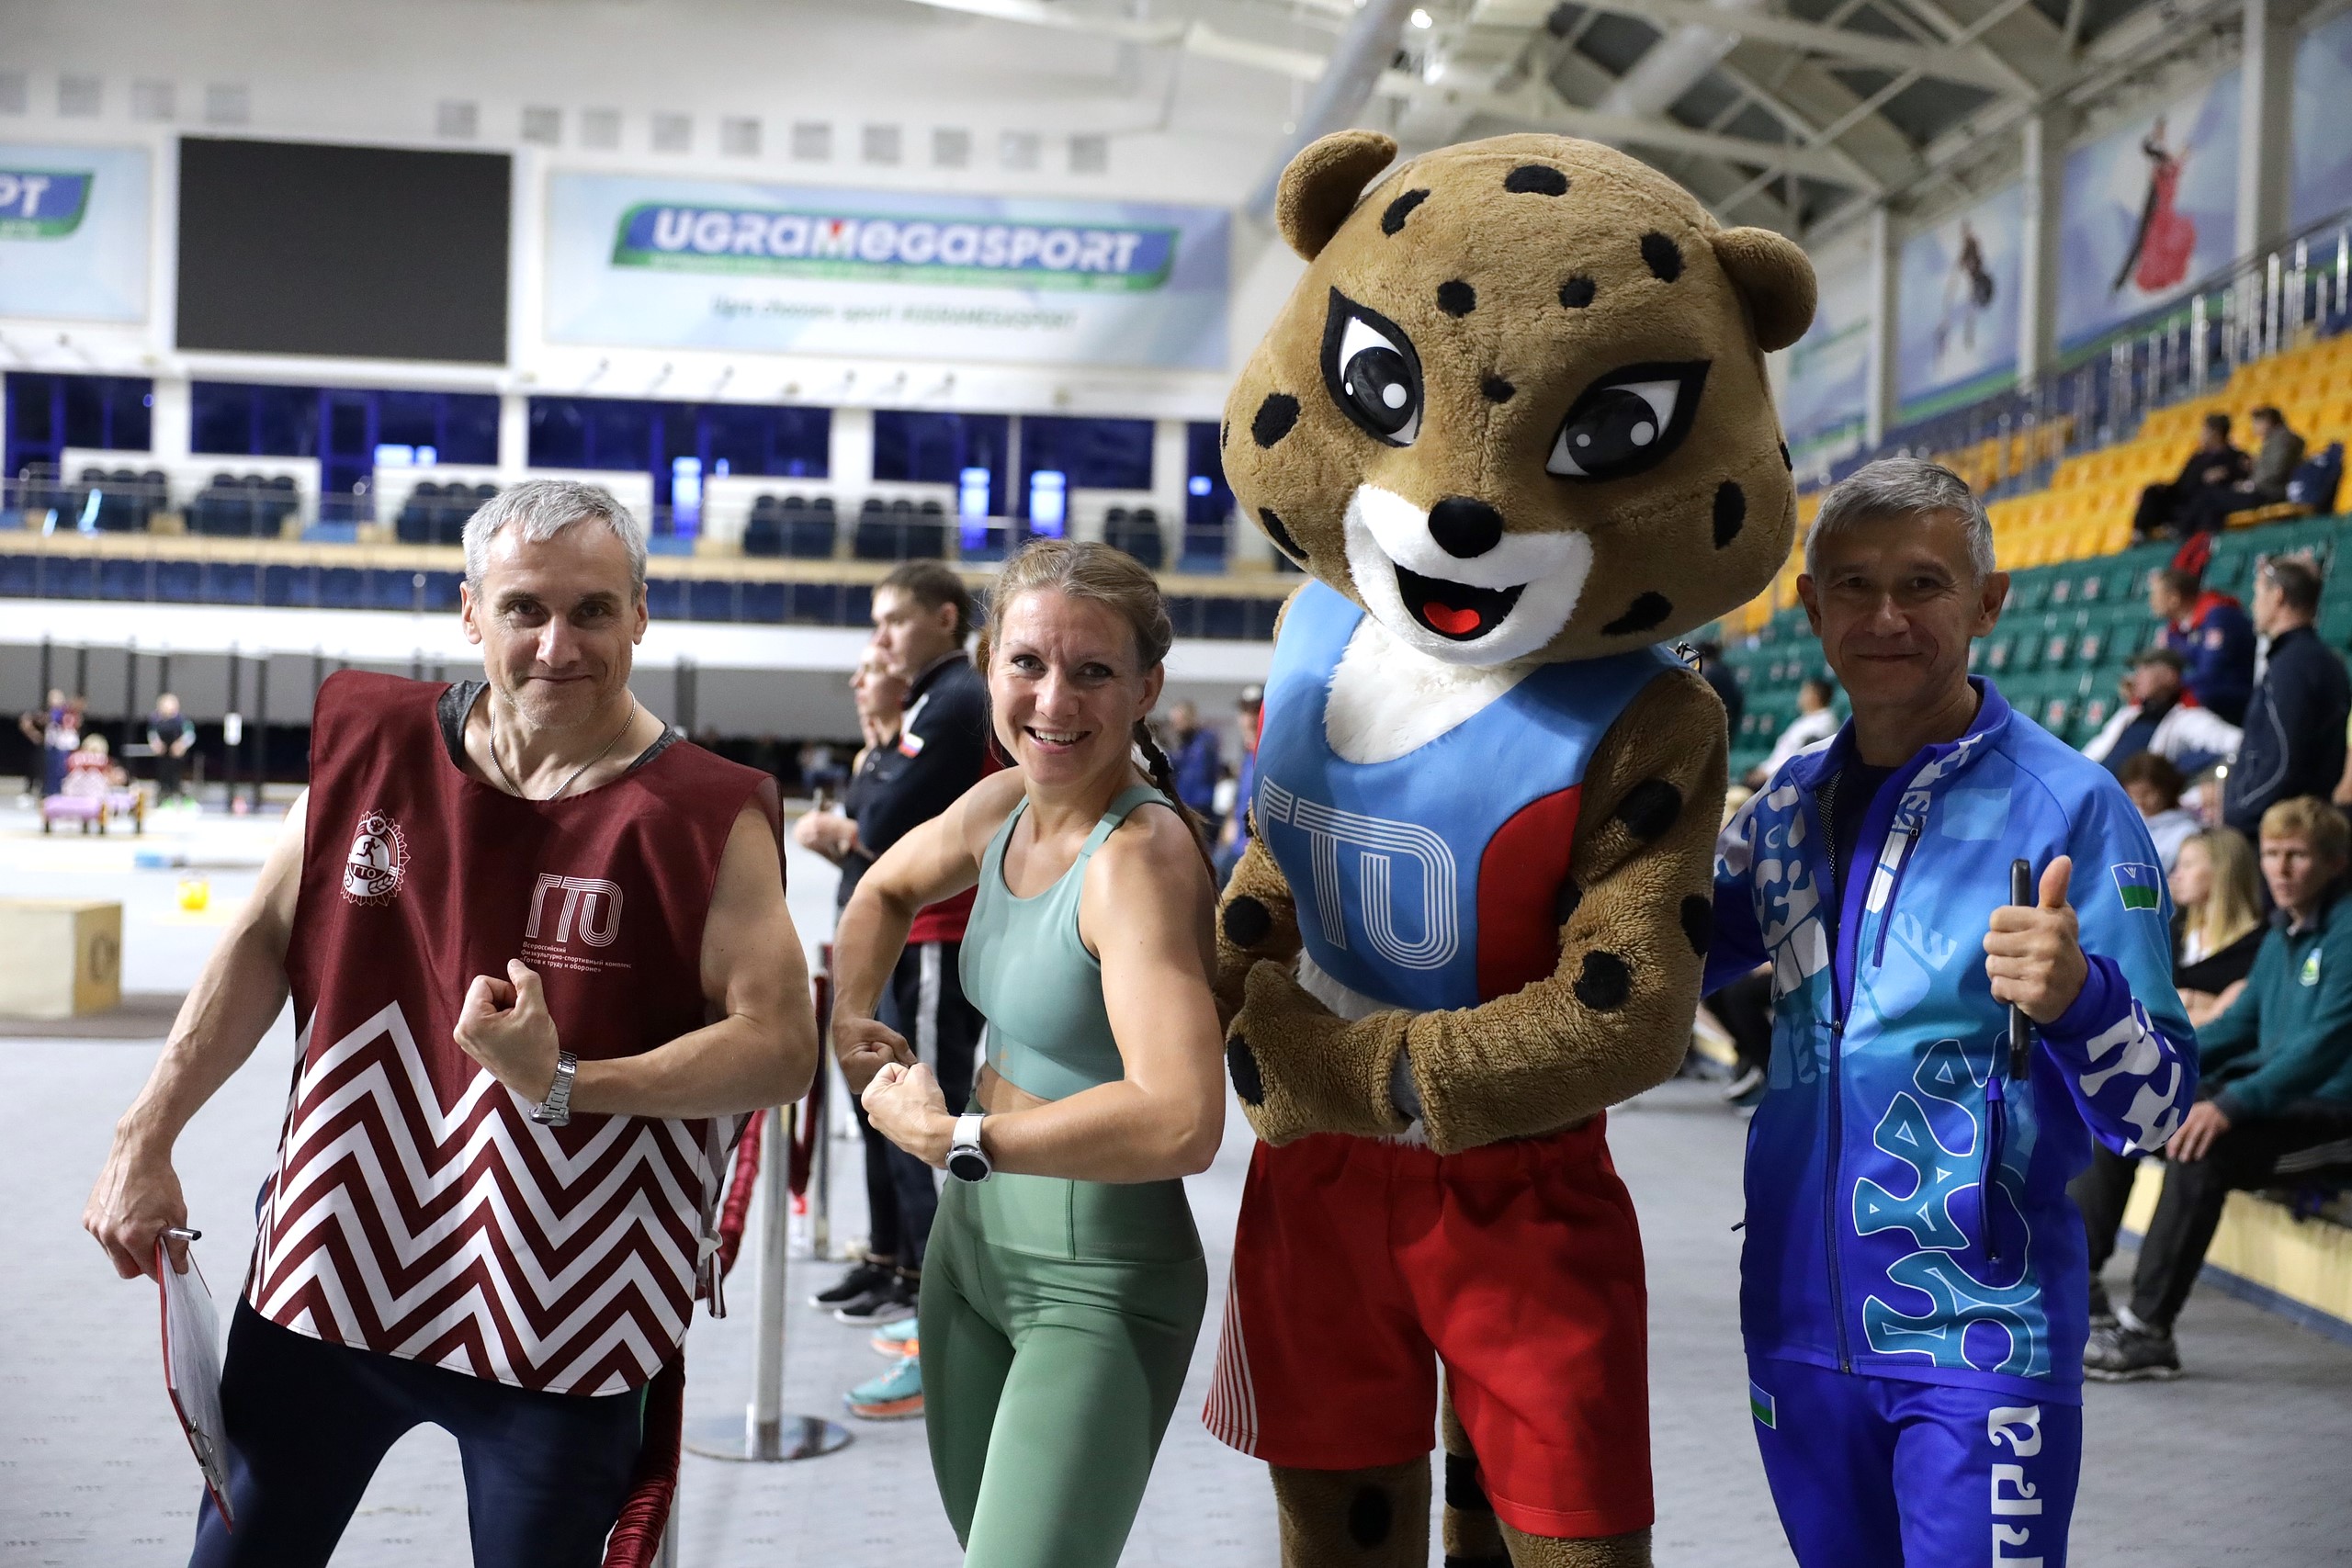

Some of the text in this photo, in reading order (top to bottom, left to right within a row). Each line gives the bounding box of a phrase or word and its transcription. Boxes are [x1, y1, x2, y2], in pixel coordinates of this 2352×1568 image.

[353, 864, 377, 879] ГТО
[1256, 774, 1459, 970] ГТО
[526, 873, 624, 947] ГТО
[522, 941, 567, 953] Всероссийский
[547, 961, 563, 969] труду
